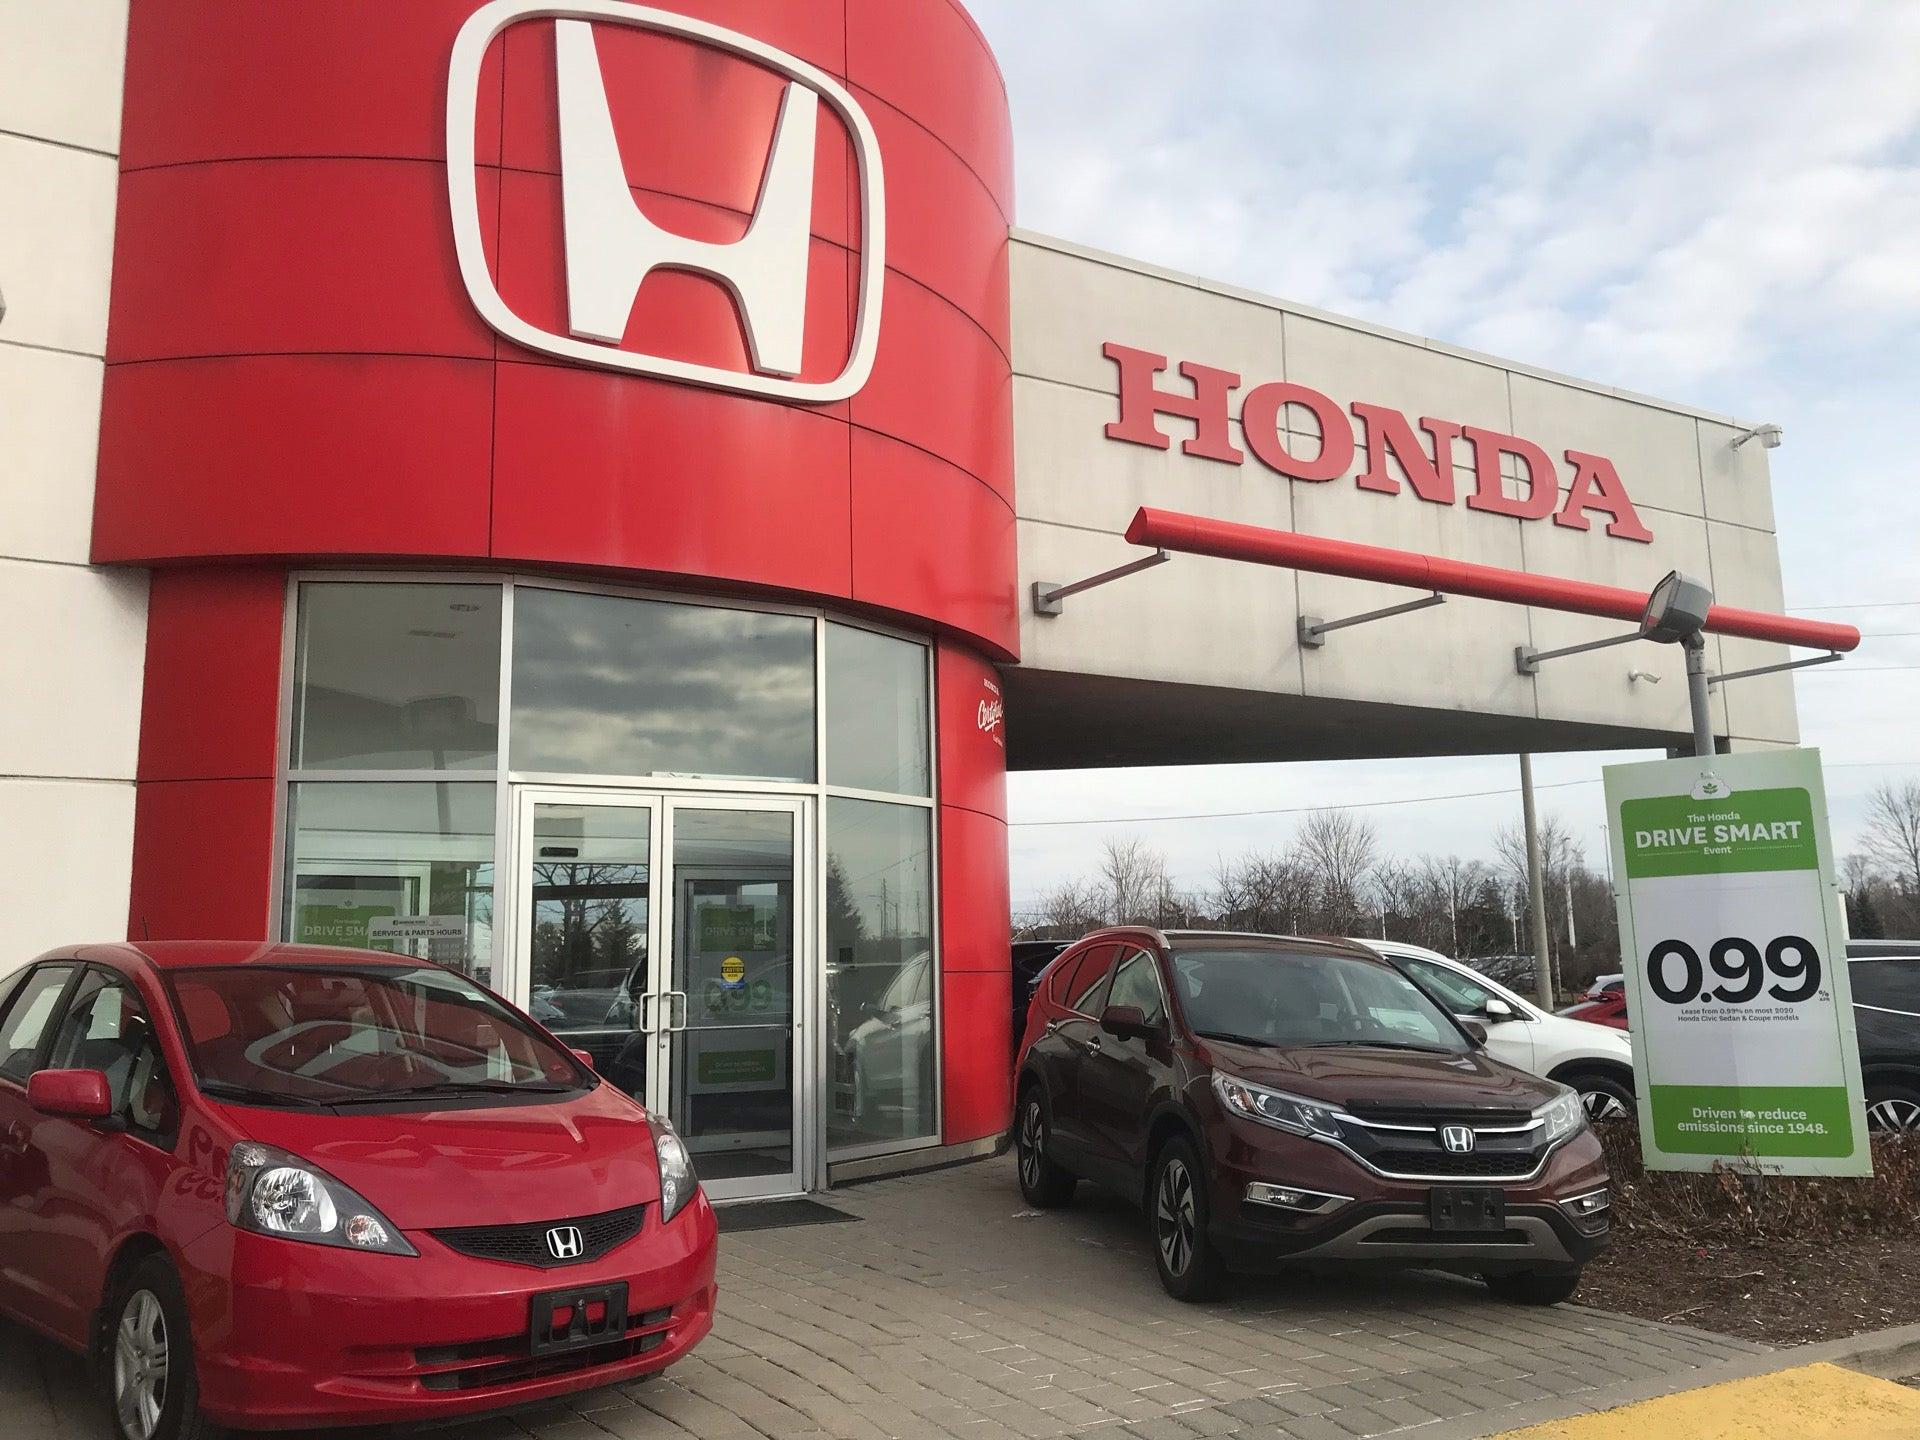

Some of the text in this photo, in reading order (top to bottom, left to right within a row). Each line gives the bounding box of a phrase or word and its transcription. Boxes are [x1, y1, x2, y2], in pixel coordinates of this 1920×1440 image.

[1102, 341, 1654, 543] HONDA
[1687, 811, 1741, 823] The Honda
[1635, 821, 1802, 849] DRIVE SMART
[1703, 846, 1732, 855] Event
[304, 925, 343, 936] DRIVE
[372, 929, 403, 937] SERVICE
[436, 928, 462, 936] HOURS
[1647, 935, 1822, 1005] 0.99
[1748, 1015, 1771, 1023] Coupe
[1692, 1106, 1737, 1119] Driven
[1758, 1107, 1807, 1120] reduce
[1677, 1120, 1828, 1135] emissions since 1948.
